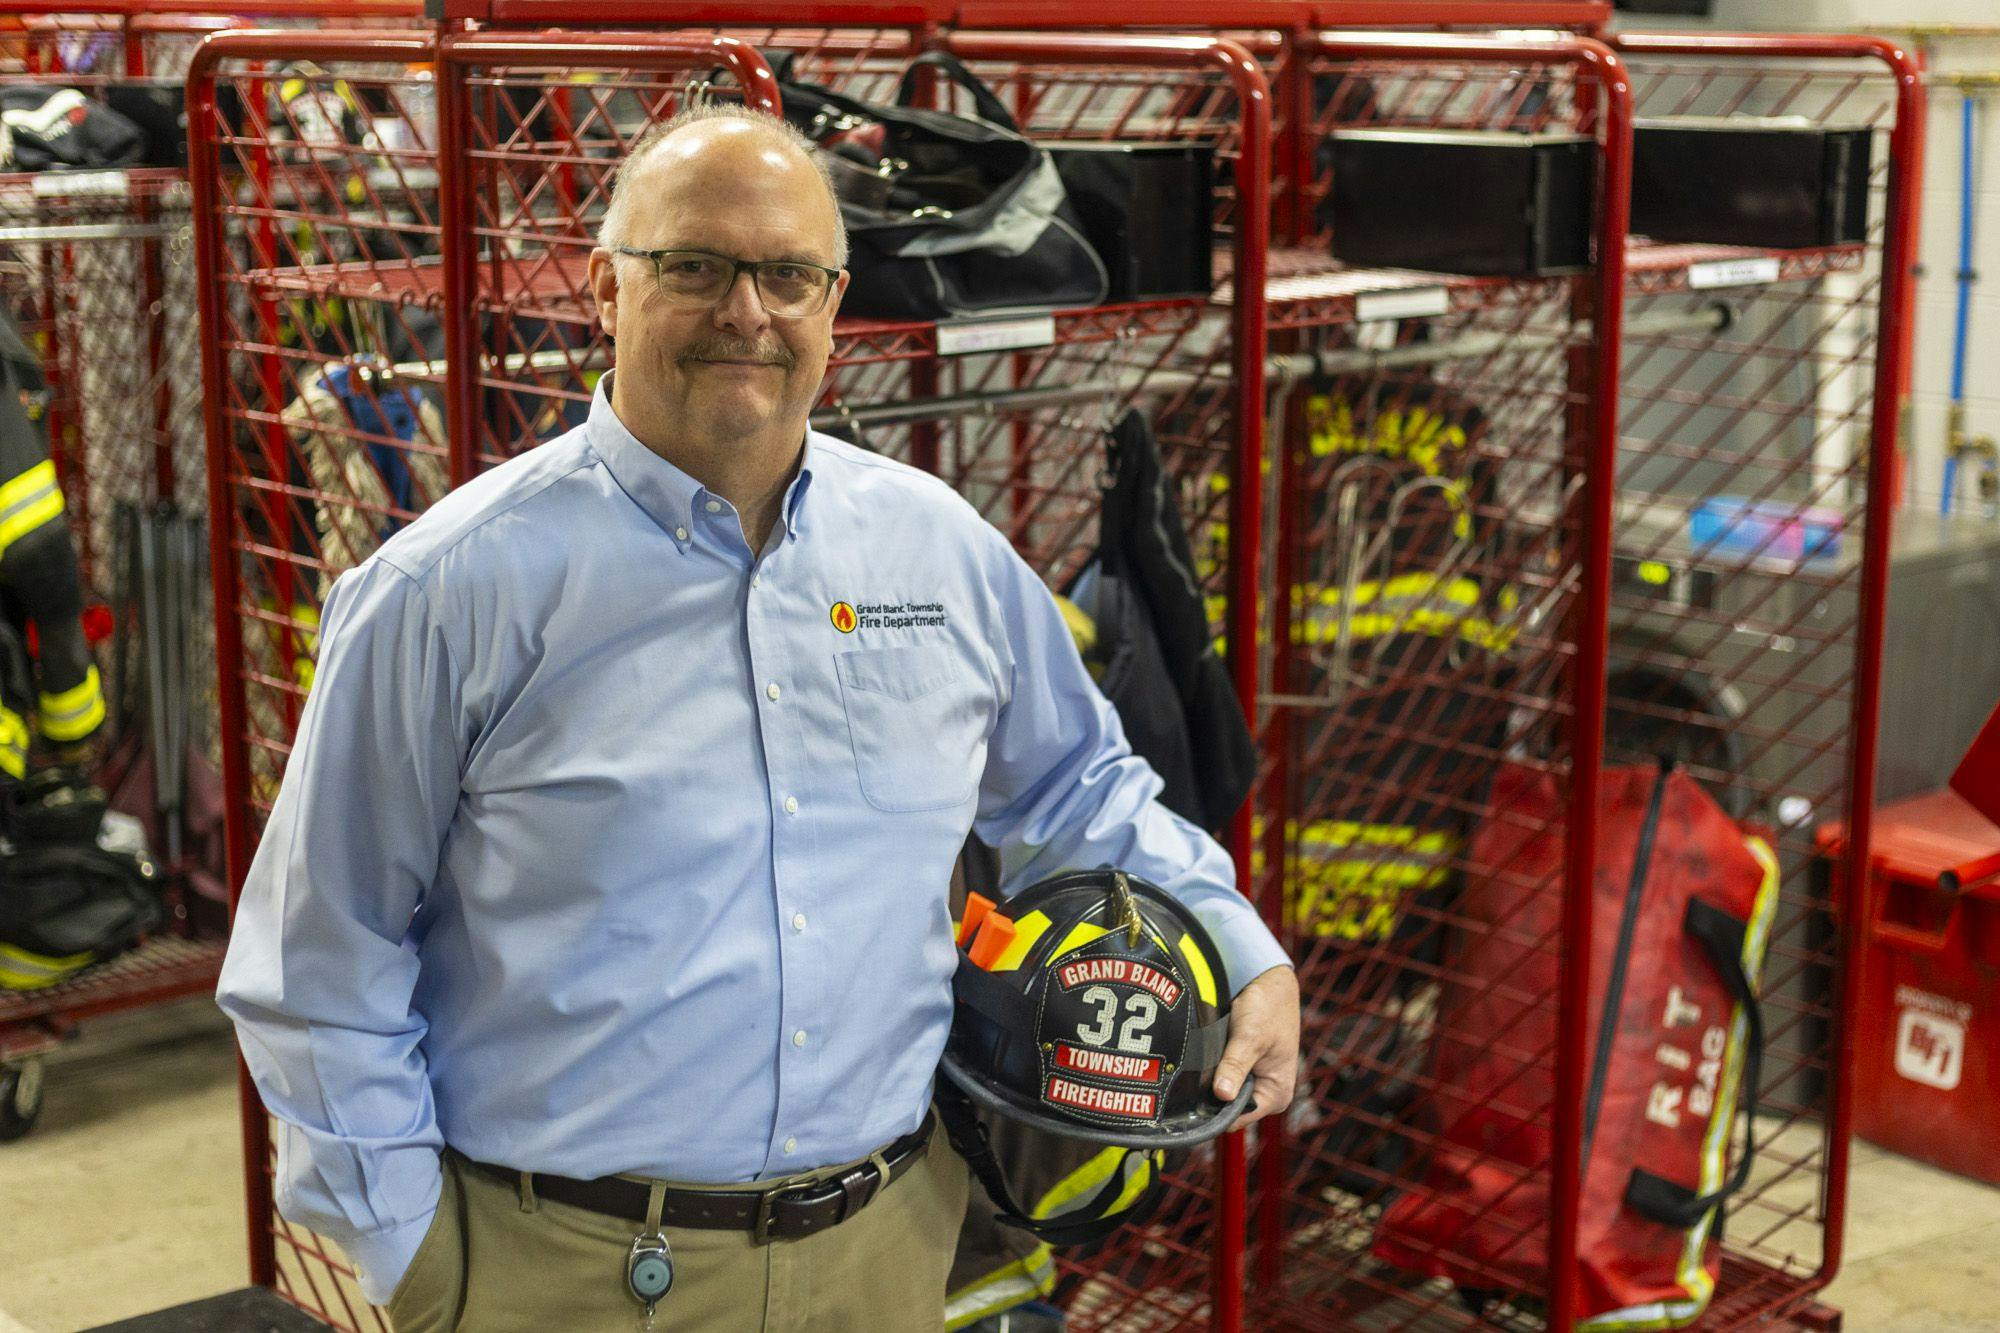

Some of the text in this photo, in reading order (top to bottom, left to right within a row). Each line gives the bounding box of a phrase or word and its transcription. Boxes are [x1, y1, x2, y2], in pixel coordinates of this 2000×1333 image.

[857, 602, 944, 614] Grand Blanc Township
[860, 615, 945, 629] Fire Department
[1065, 960, 1177, 1006] GRAND BLANC
[1076, 985, 1158, 1055] 32
[1068, 1047, 1150, 1078] TOWNSHIP
[1053, 1080, 1152, 1114] FIREFIGHTER
